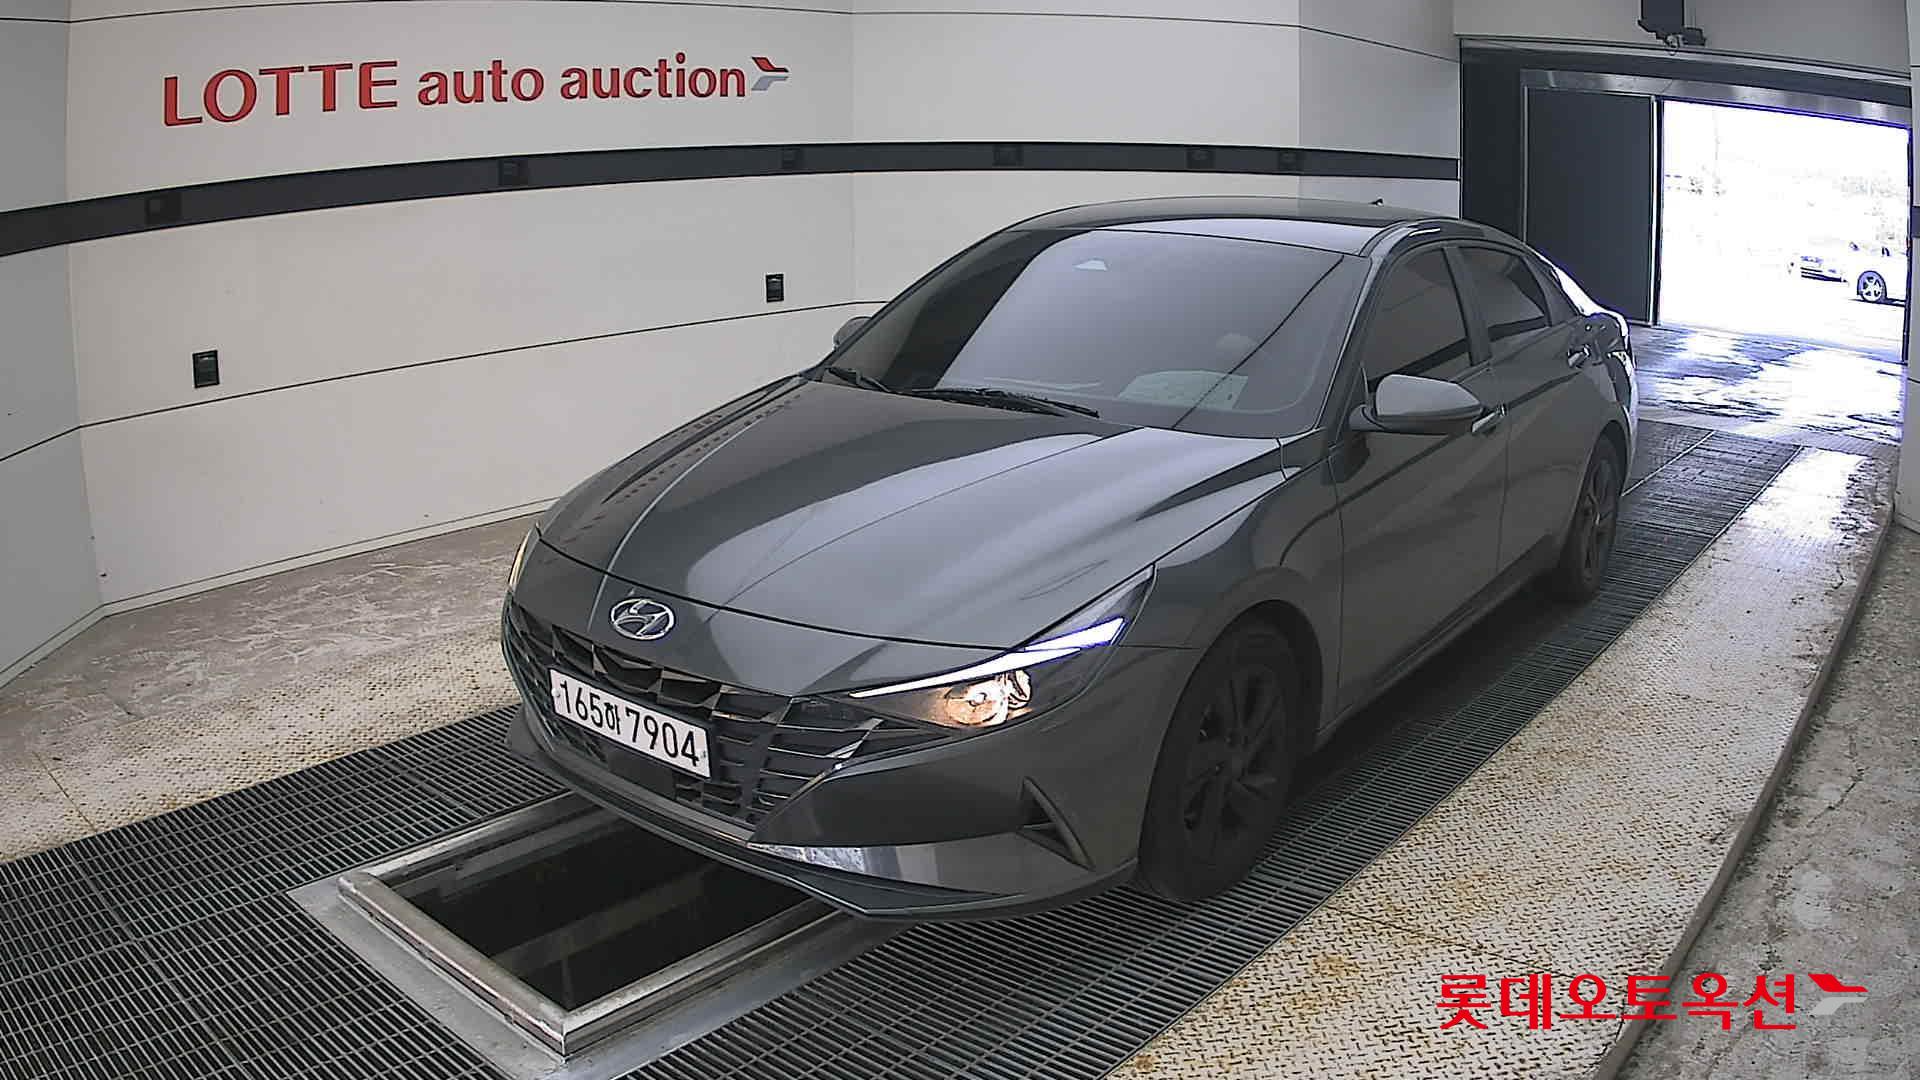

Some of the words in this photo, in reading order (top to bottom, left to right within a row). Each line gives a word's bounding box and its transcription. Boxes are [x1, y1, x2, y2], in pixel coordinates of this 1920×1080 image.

[163, 60, 399, 126] LOTTE
[417, 58, 545, 107] auto
[559, 52, 747, 99] auction
